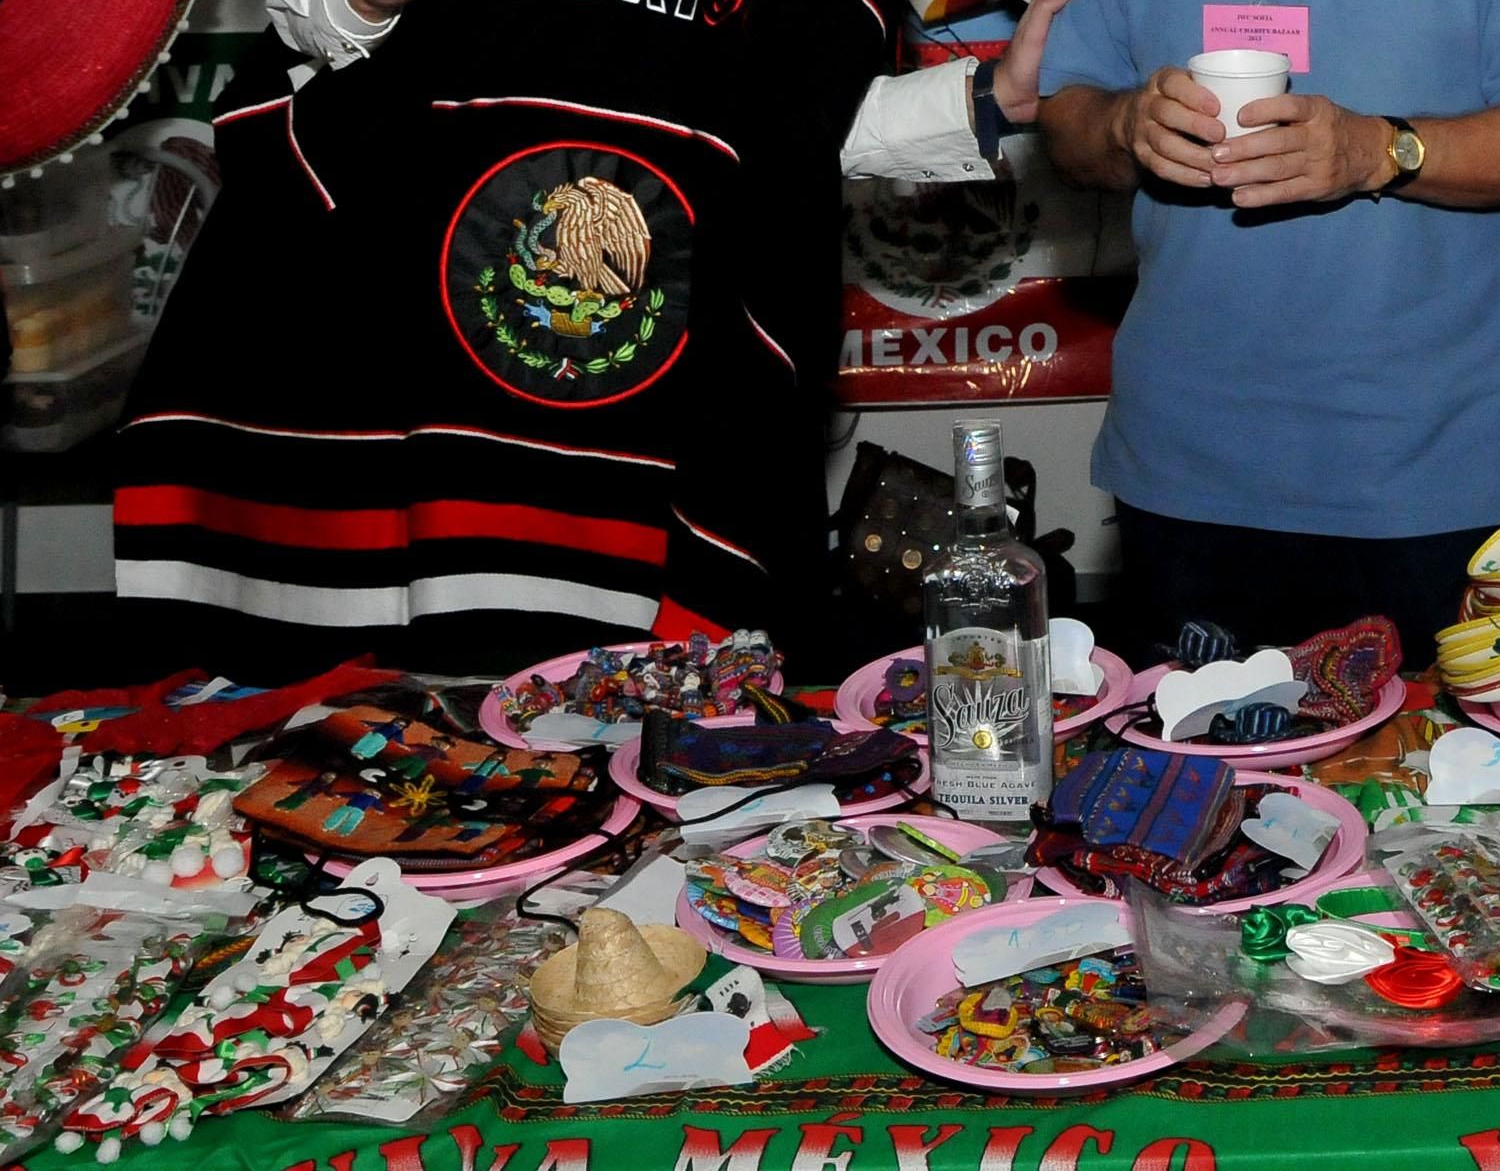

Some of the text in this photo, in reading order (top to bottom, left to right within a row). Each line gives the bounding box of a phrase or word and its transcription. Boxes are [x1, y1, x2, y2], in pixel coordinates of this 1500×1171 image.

[838, 322, 1058, 365] MEXICO
[932, 683, 1030, 749] Sauza
[938, 793, 1029, 805] TEQUILA SILVER
